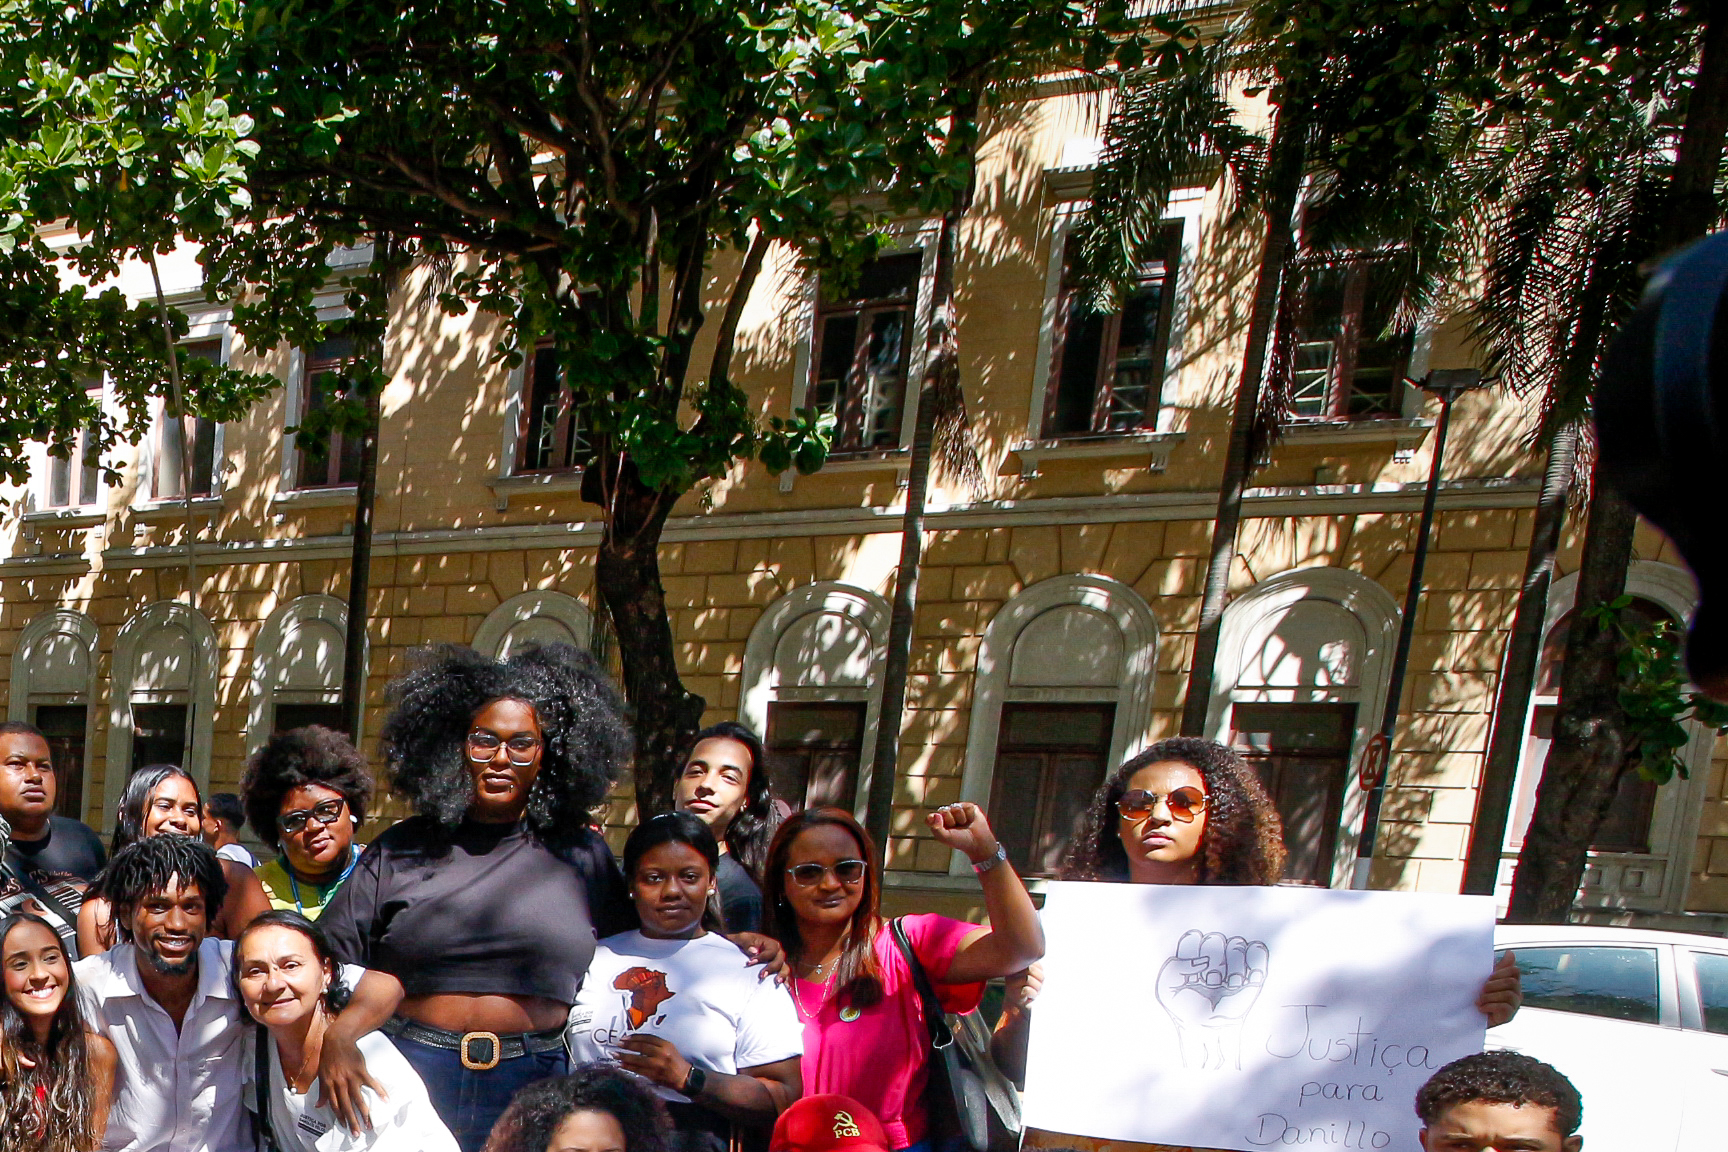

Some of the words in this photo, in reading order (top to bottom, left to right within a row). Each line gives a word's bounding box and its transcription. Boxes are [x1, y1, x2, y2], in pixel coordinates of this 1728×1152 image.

[1265, 1004, 1439, 1076] Justiça
[1298, 1081, 1384, 1107] para
[833, 1128, 861, 1139] PCB
[1244, 1112, 1391, 1150] Danillo
